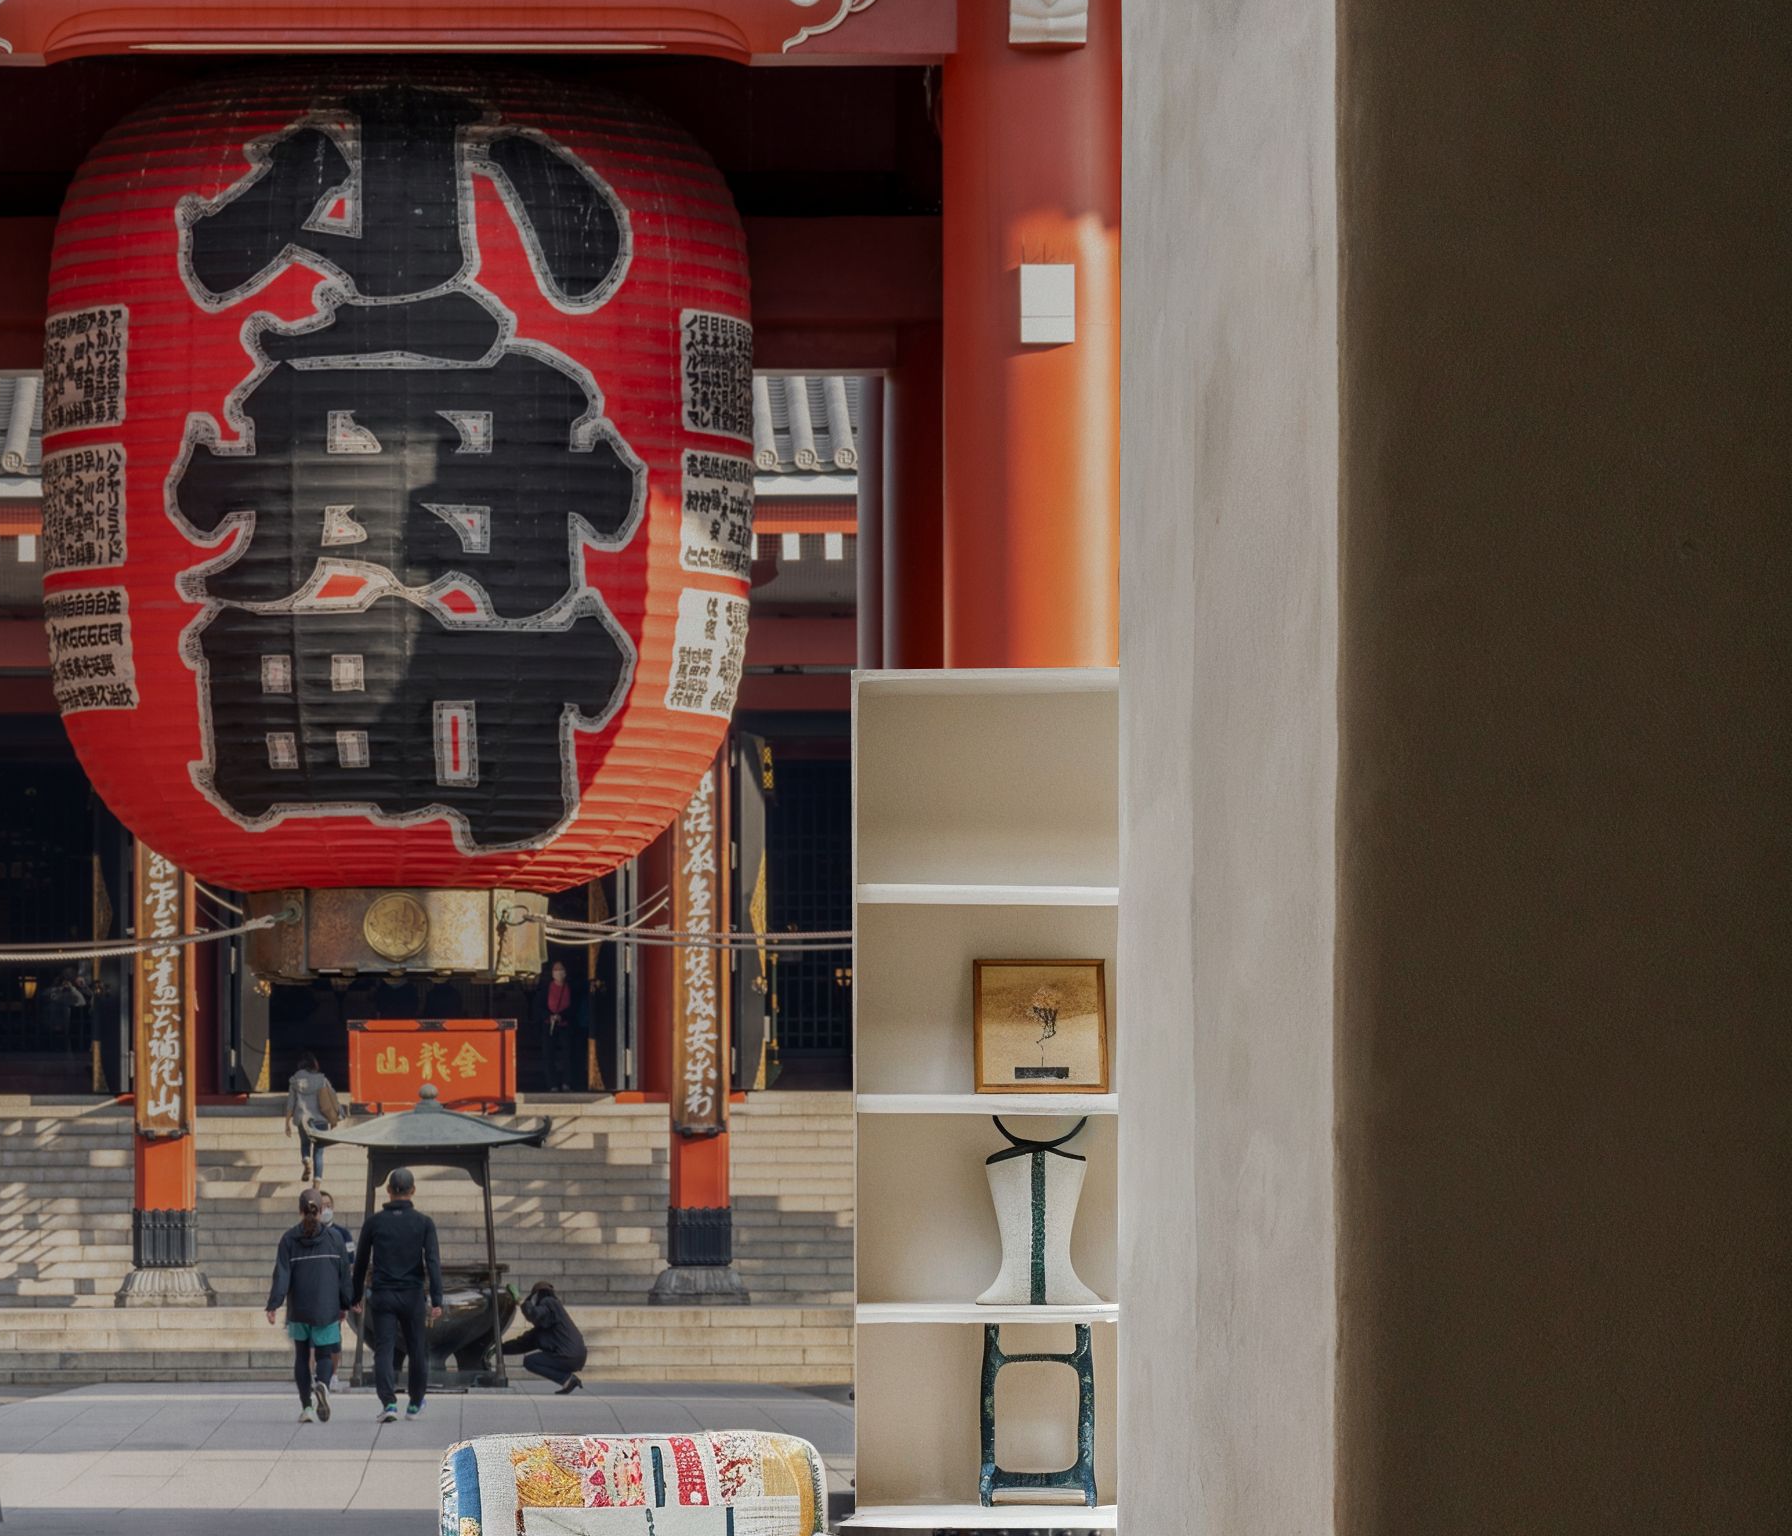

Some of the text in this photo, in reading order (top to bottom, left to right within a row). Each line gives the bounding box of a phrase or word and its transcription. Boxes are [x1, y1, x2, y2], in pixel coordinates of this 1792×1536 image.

[164, 86, 648, 854] 小舟町
[375, 1040, 489, 1083] 金龍山
